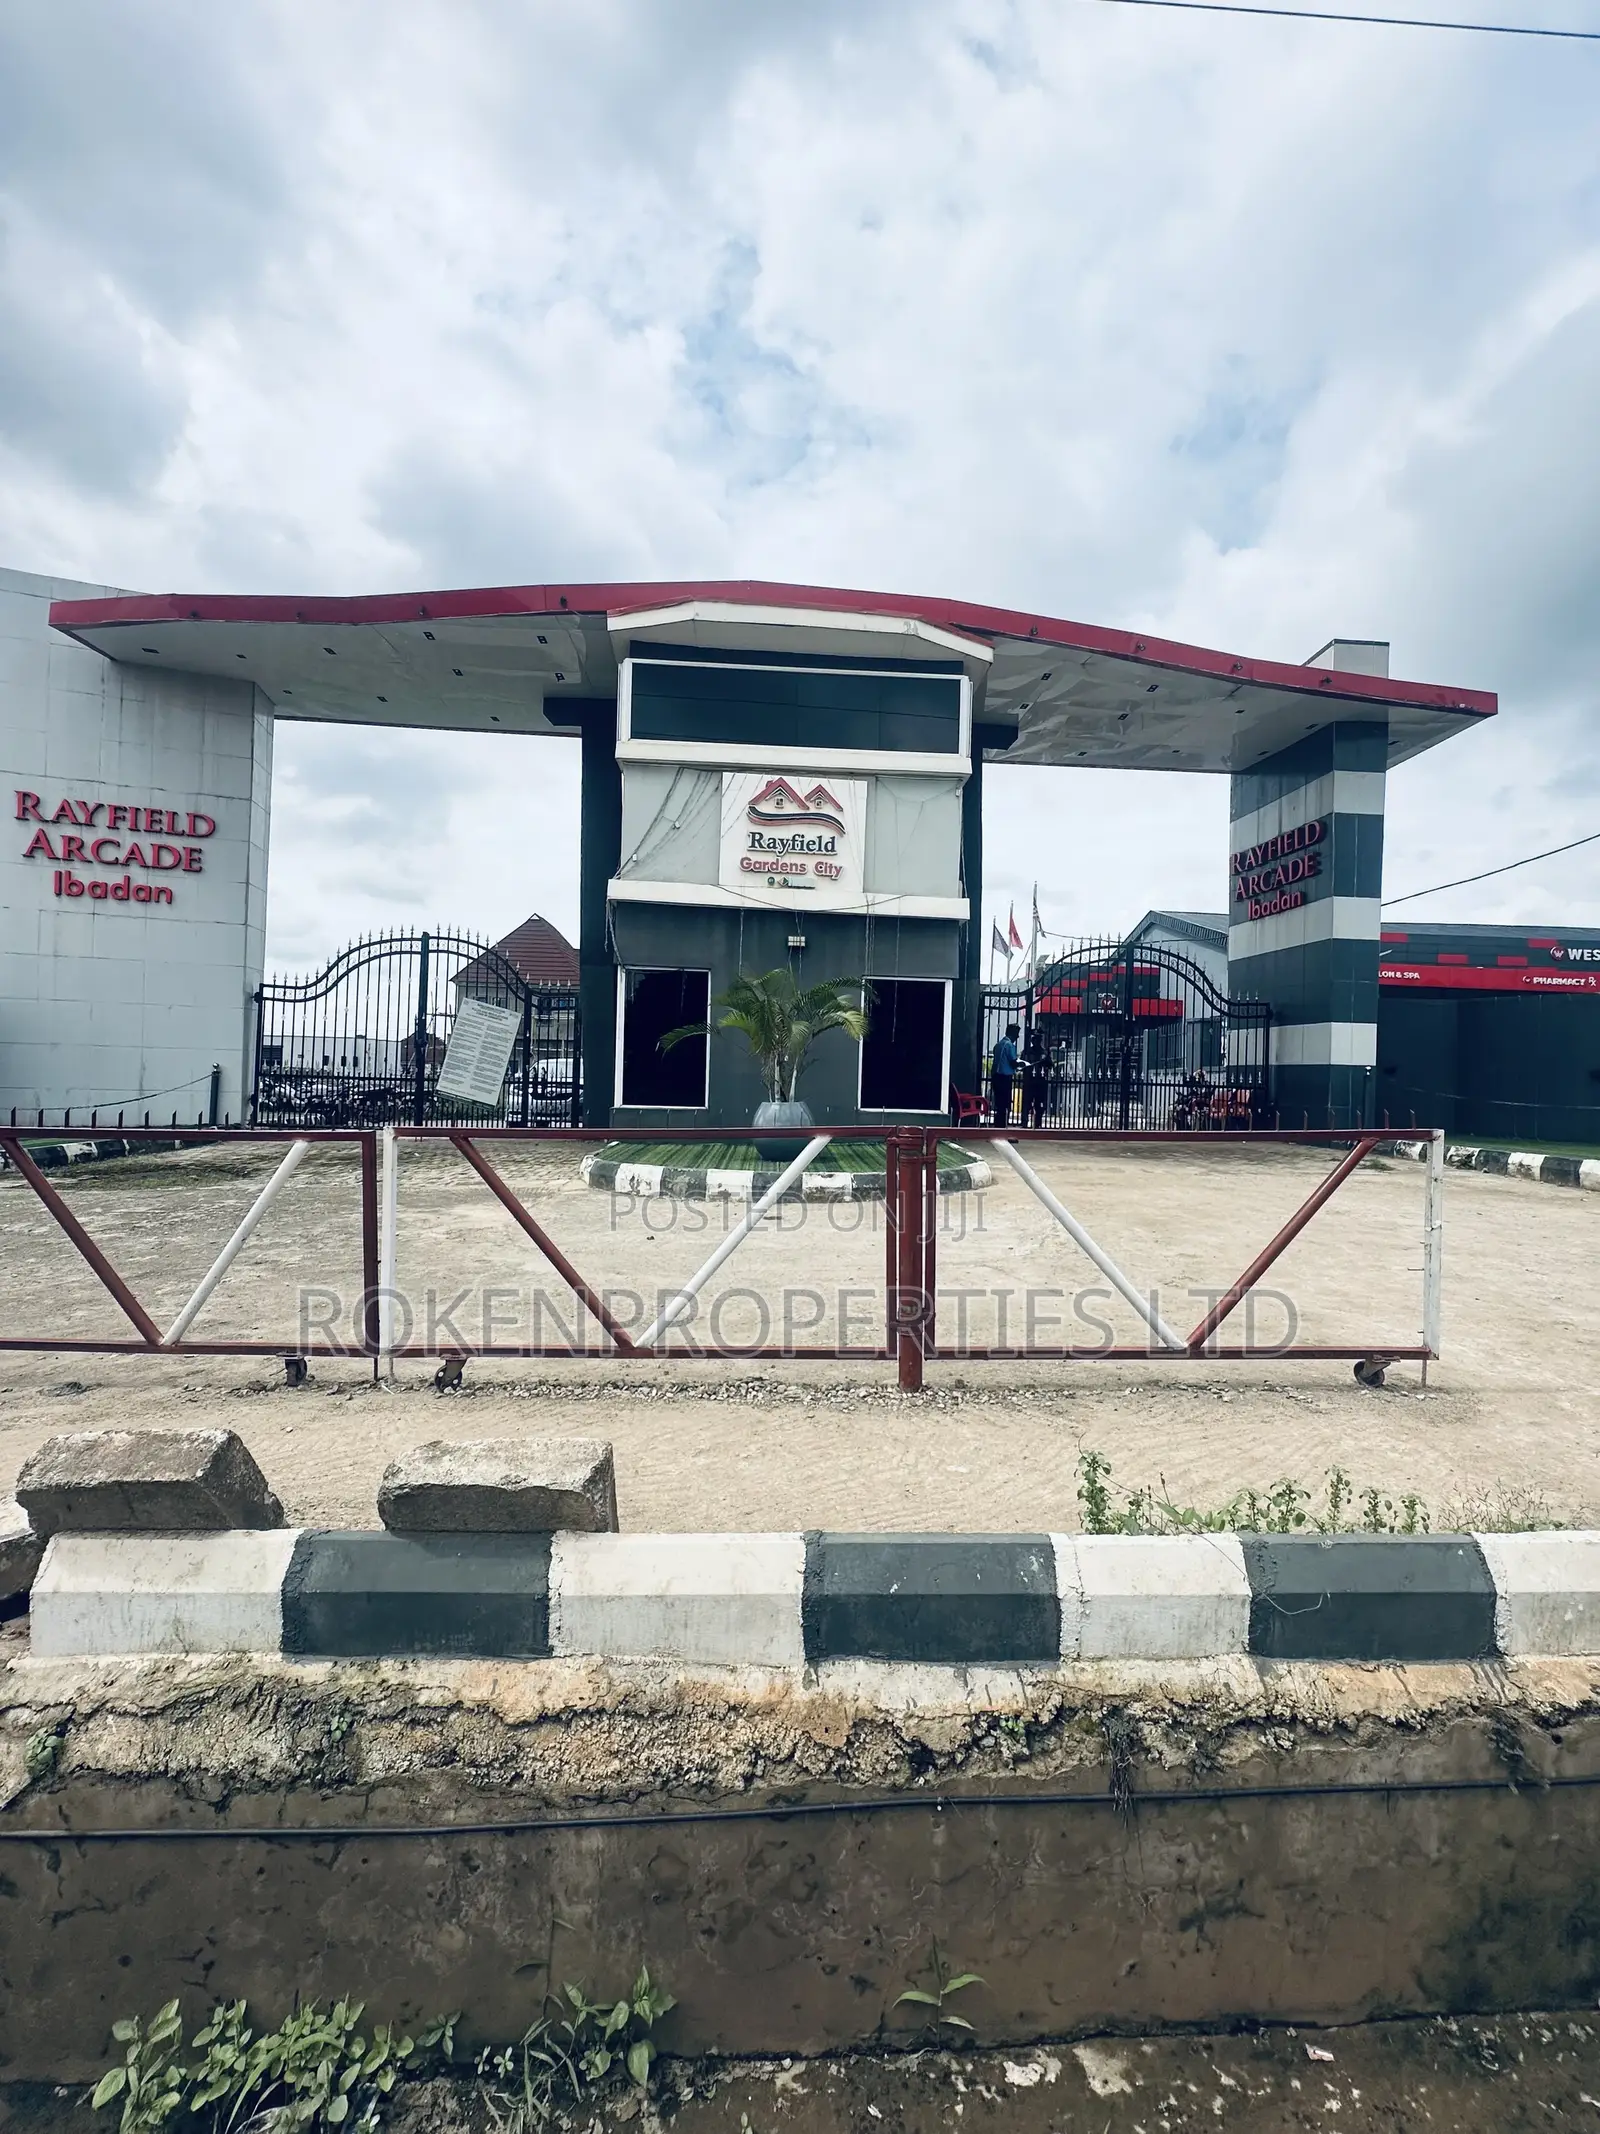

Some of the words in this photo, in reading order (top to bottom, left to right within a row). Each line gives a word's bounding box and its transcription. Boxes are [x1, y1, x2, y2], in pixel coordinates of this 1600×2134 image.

[14, 790, 216, 837] RAYFIELD
[22, 827, 203, 872] ARCADE
[747, 831, 837, 856] Rayfield
[1230, 821, 1321, 875] RAYFIELD
[739, 857, 807, 874] Gardens
[814, 861, 843, 879] City
[1236, 853, 1315, 900] ARCADE
[53, 870, 173, 904] Ibadan
[1248, 891, 1301, 920] Ibadan
[1567, 948, 1600, 961] WES
[1533, 976, 1586, 986] PHARMACY
